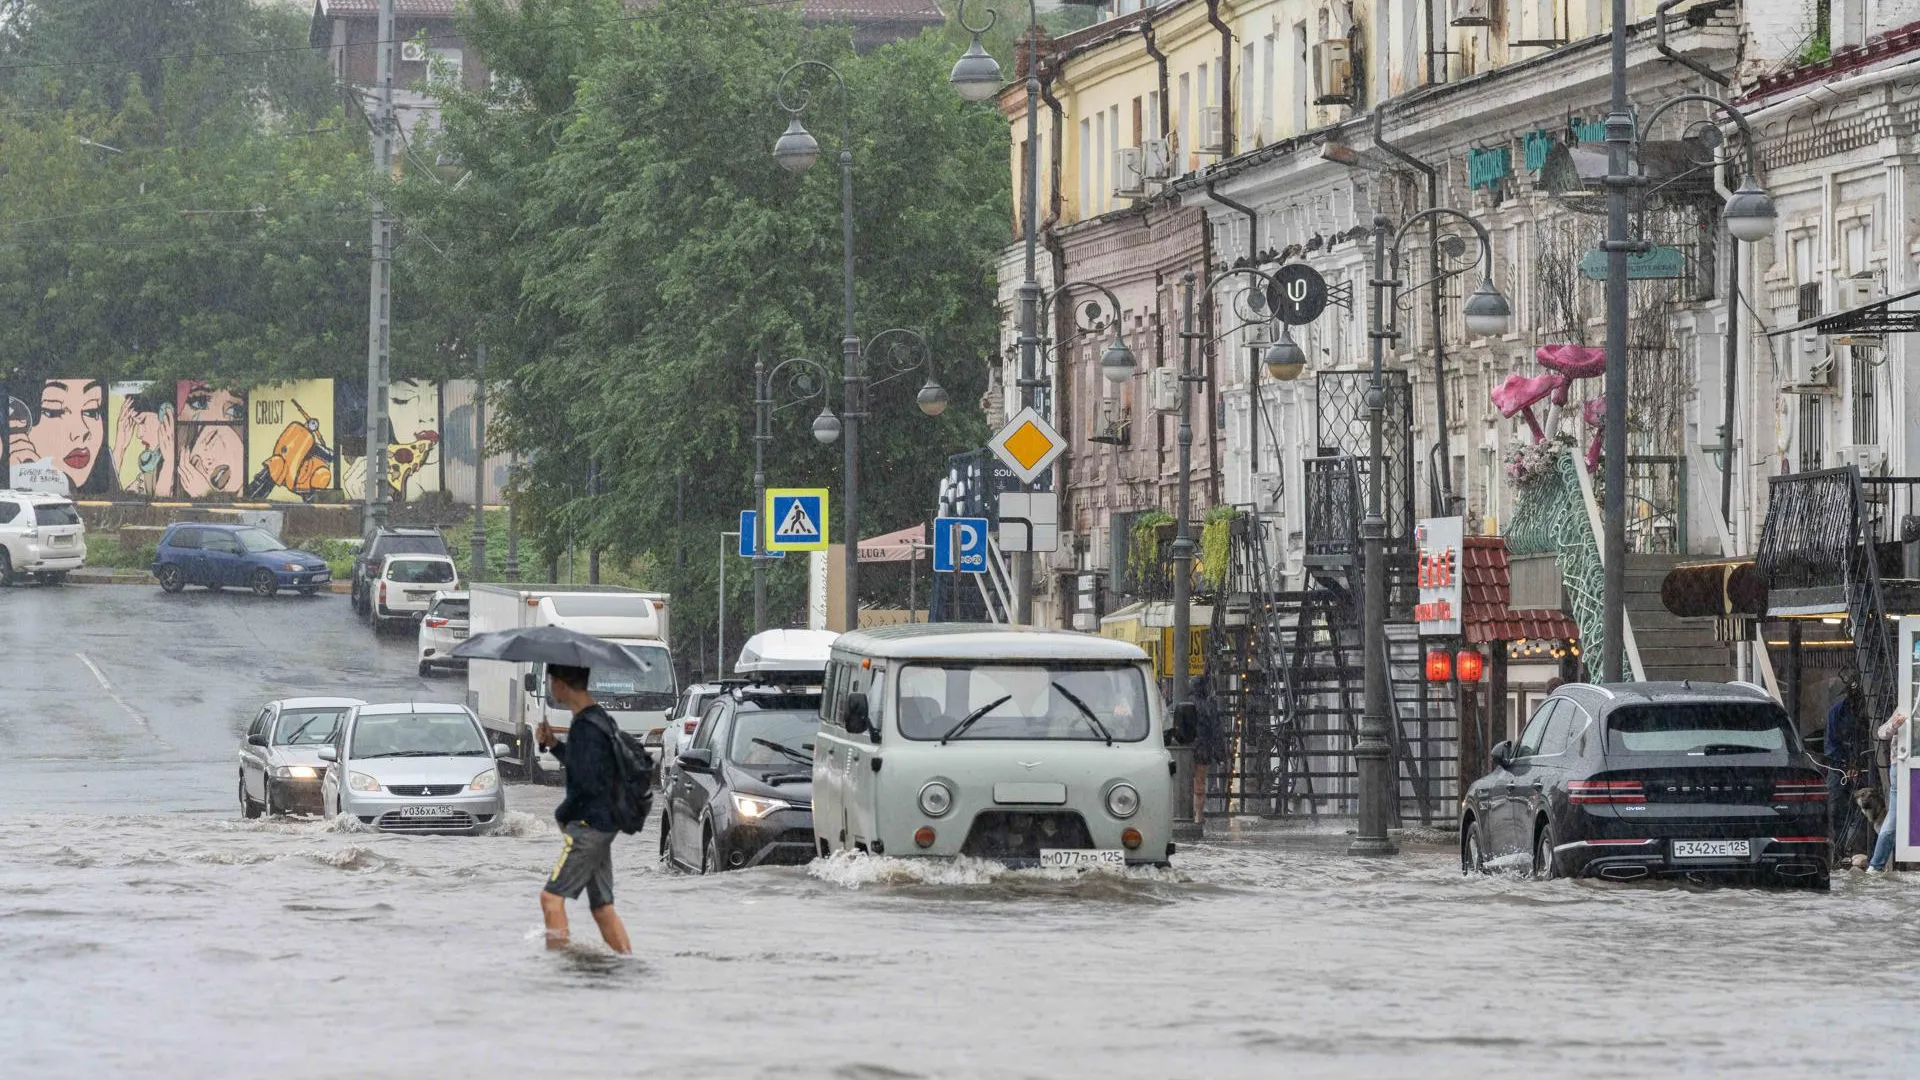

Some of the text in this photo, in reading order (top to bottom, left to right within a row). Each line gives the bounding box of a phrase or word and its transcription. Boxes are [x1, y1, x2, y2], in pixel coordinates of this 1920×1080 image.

[256, 400, 285, 424] CRUST
[994, 469, 1016, 477] SOUV
[858, 548, 886, 558] ELUGA
[439, 805, 450, 813] 125
[1679, 842, 1746, 855] Р342ХЕ 125
[1100, 851, 1121, 862] 125
